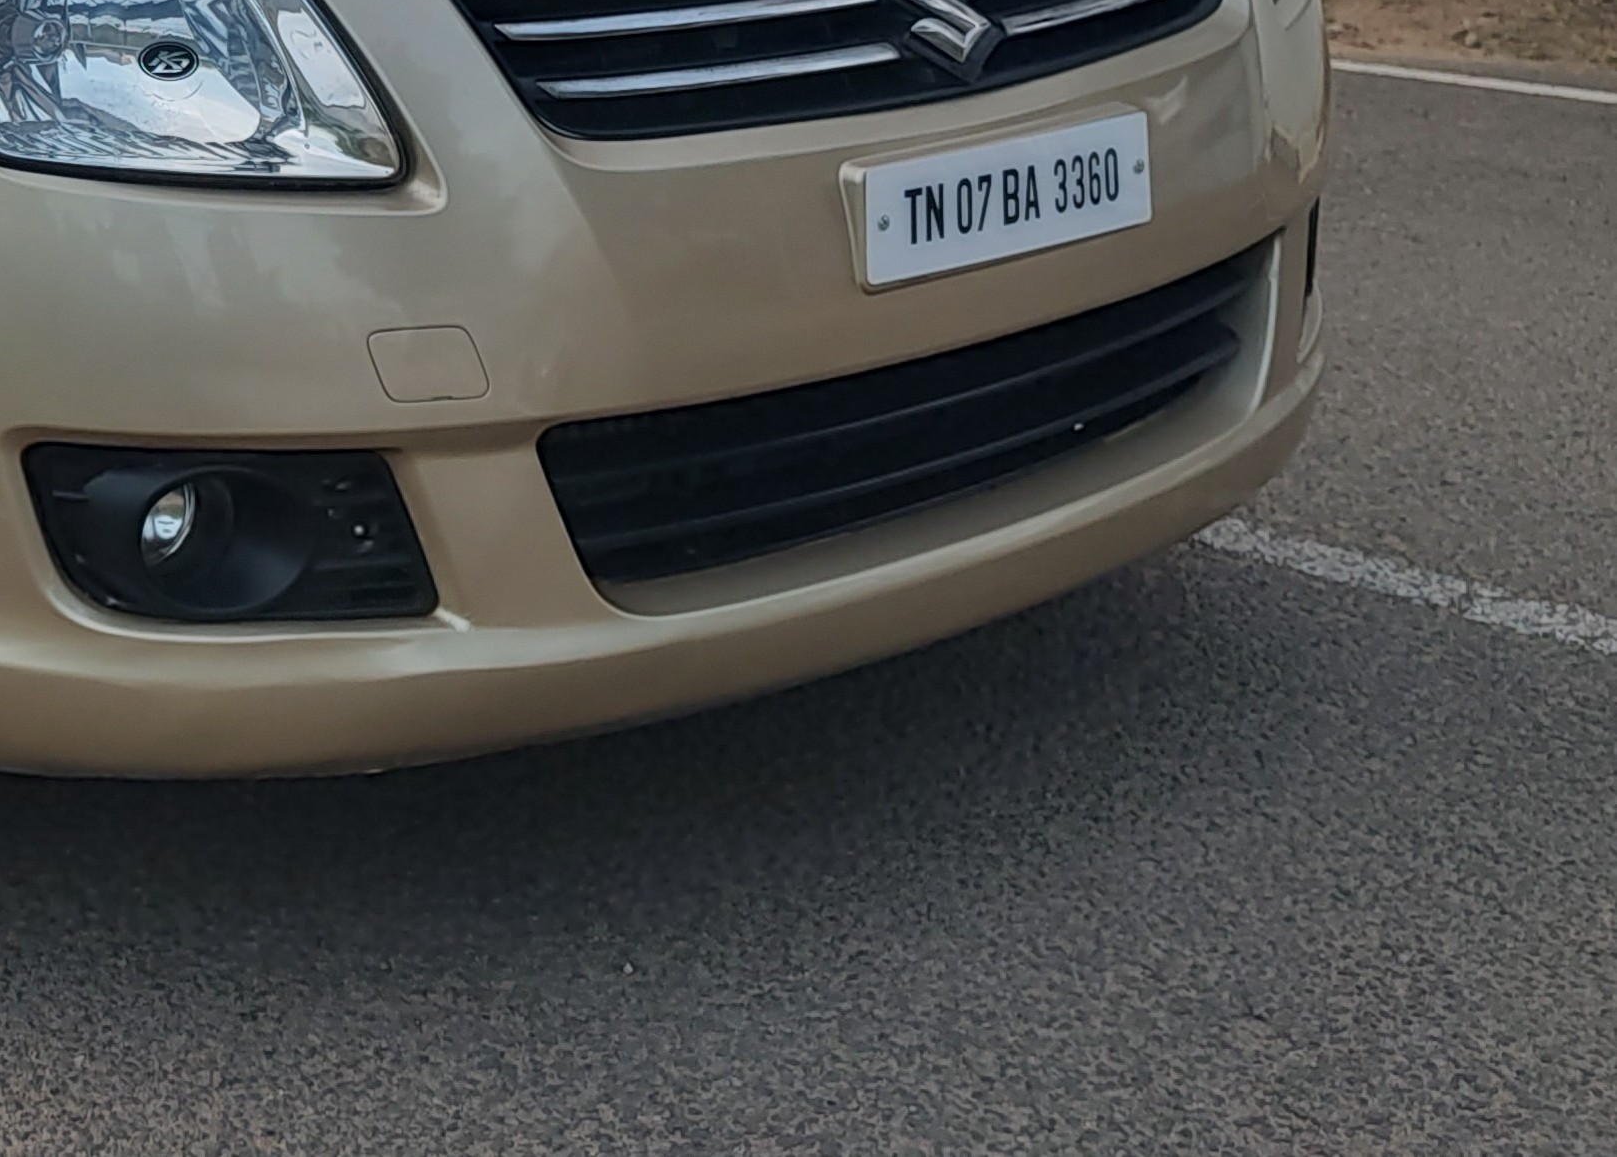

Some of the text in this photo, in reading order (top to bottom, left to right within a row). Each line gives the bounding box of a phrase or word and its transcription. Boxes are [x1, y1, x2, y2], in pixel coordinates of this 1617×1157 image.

[903, 147, 1120, 245] TN 07 BA 3360
